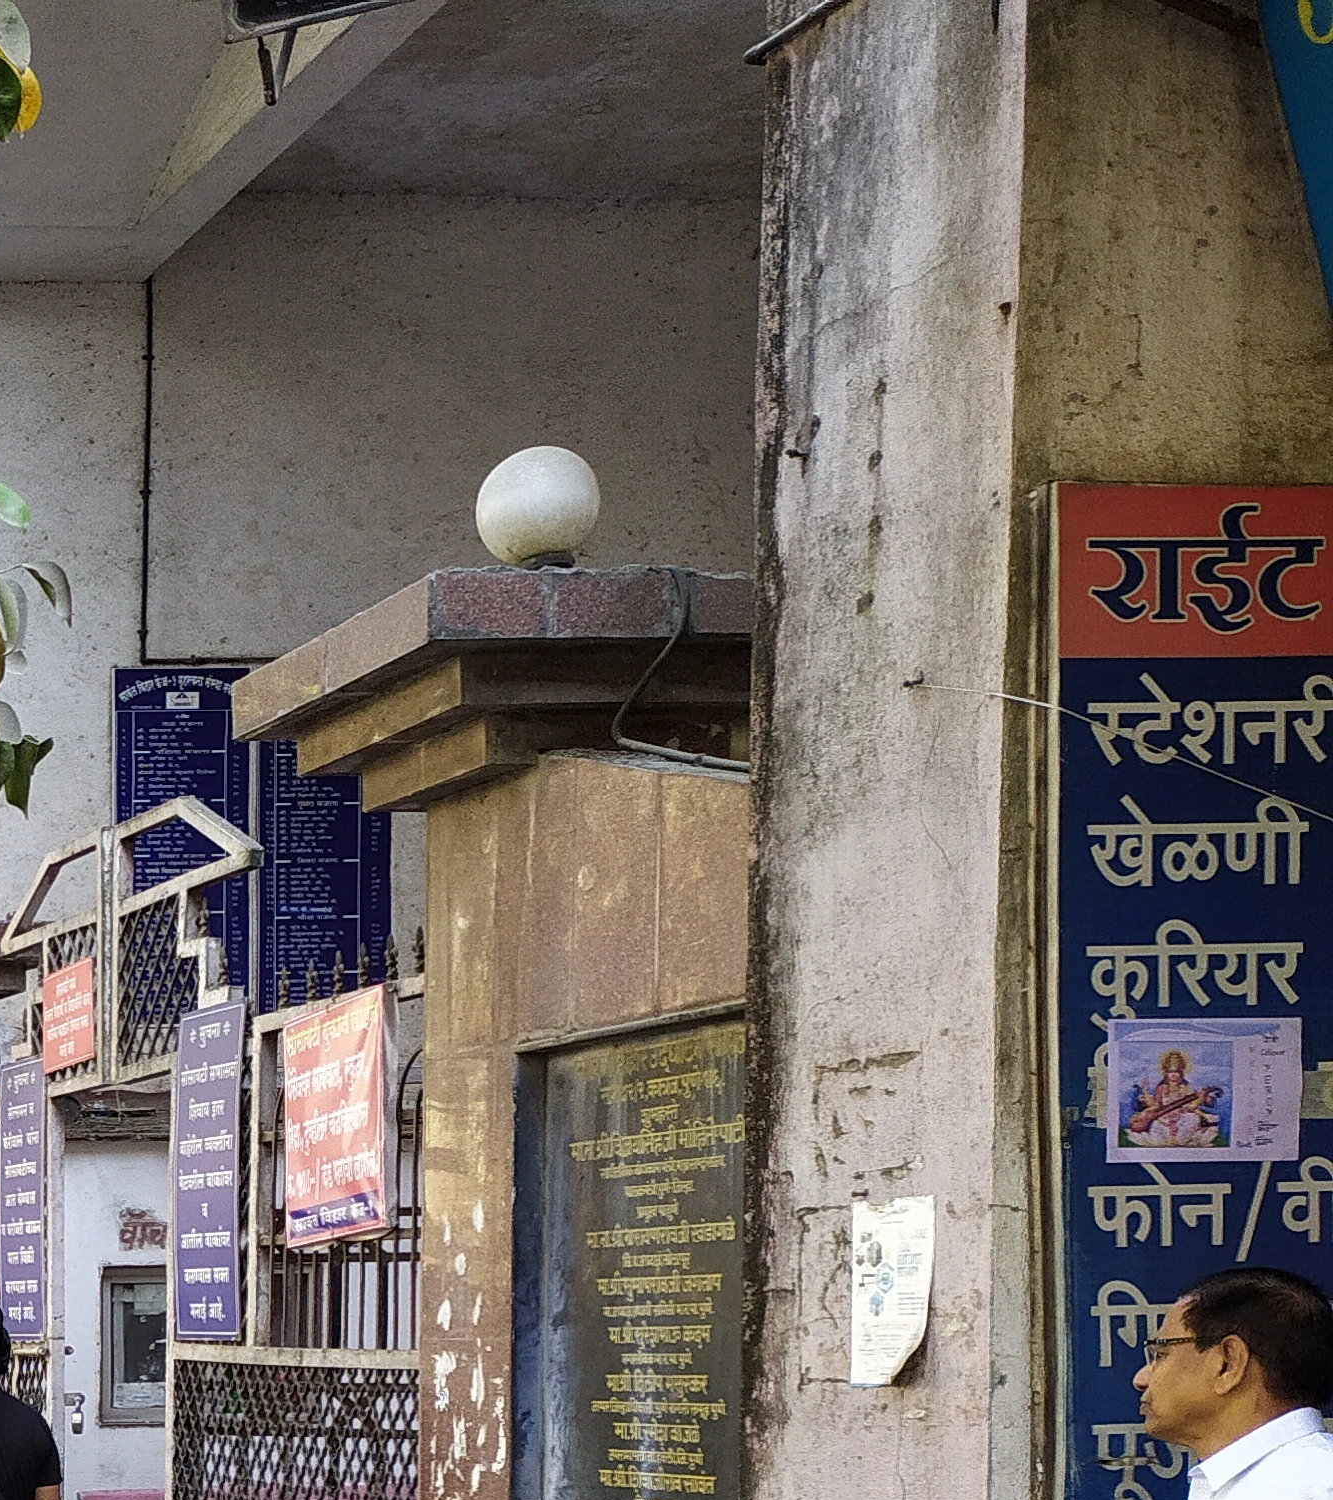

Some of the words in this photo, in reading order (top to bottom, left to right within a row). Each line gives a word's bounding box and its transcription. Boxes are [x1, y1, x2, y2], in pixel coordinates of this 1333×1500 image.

[1087, 503, 1326, 634] राईट
[1087, 795, 1309, 887] खेळणी
[1086, 920, 1303, 1018] कुरियर
